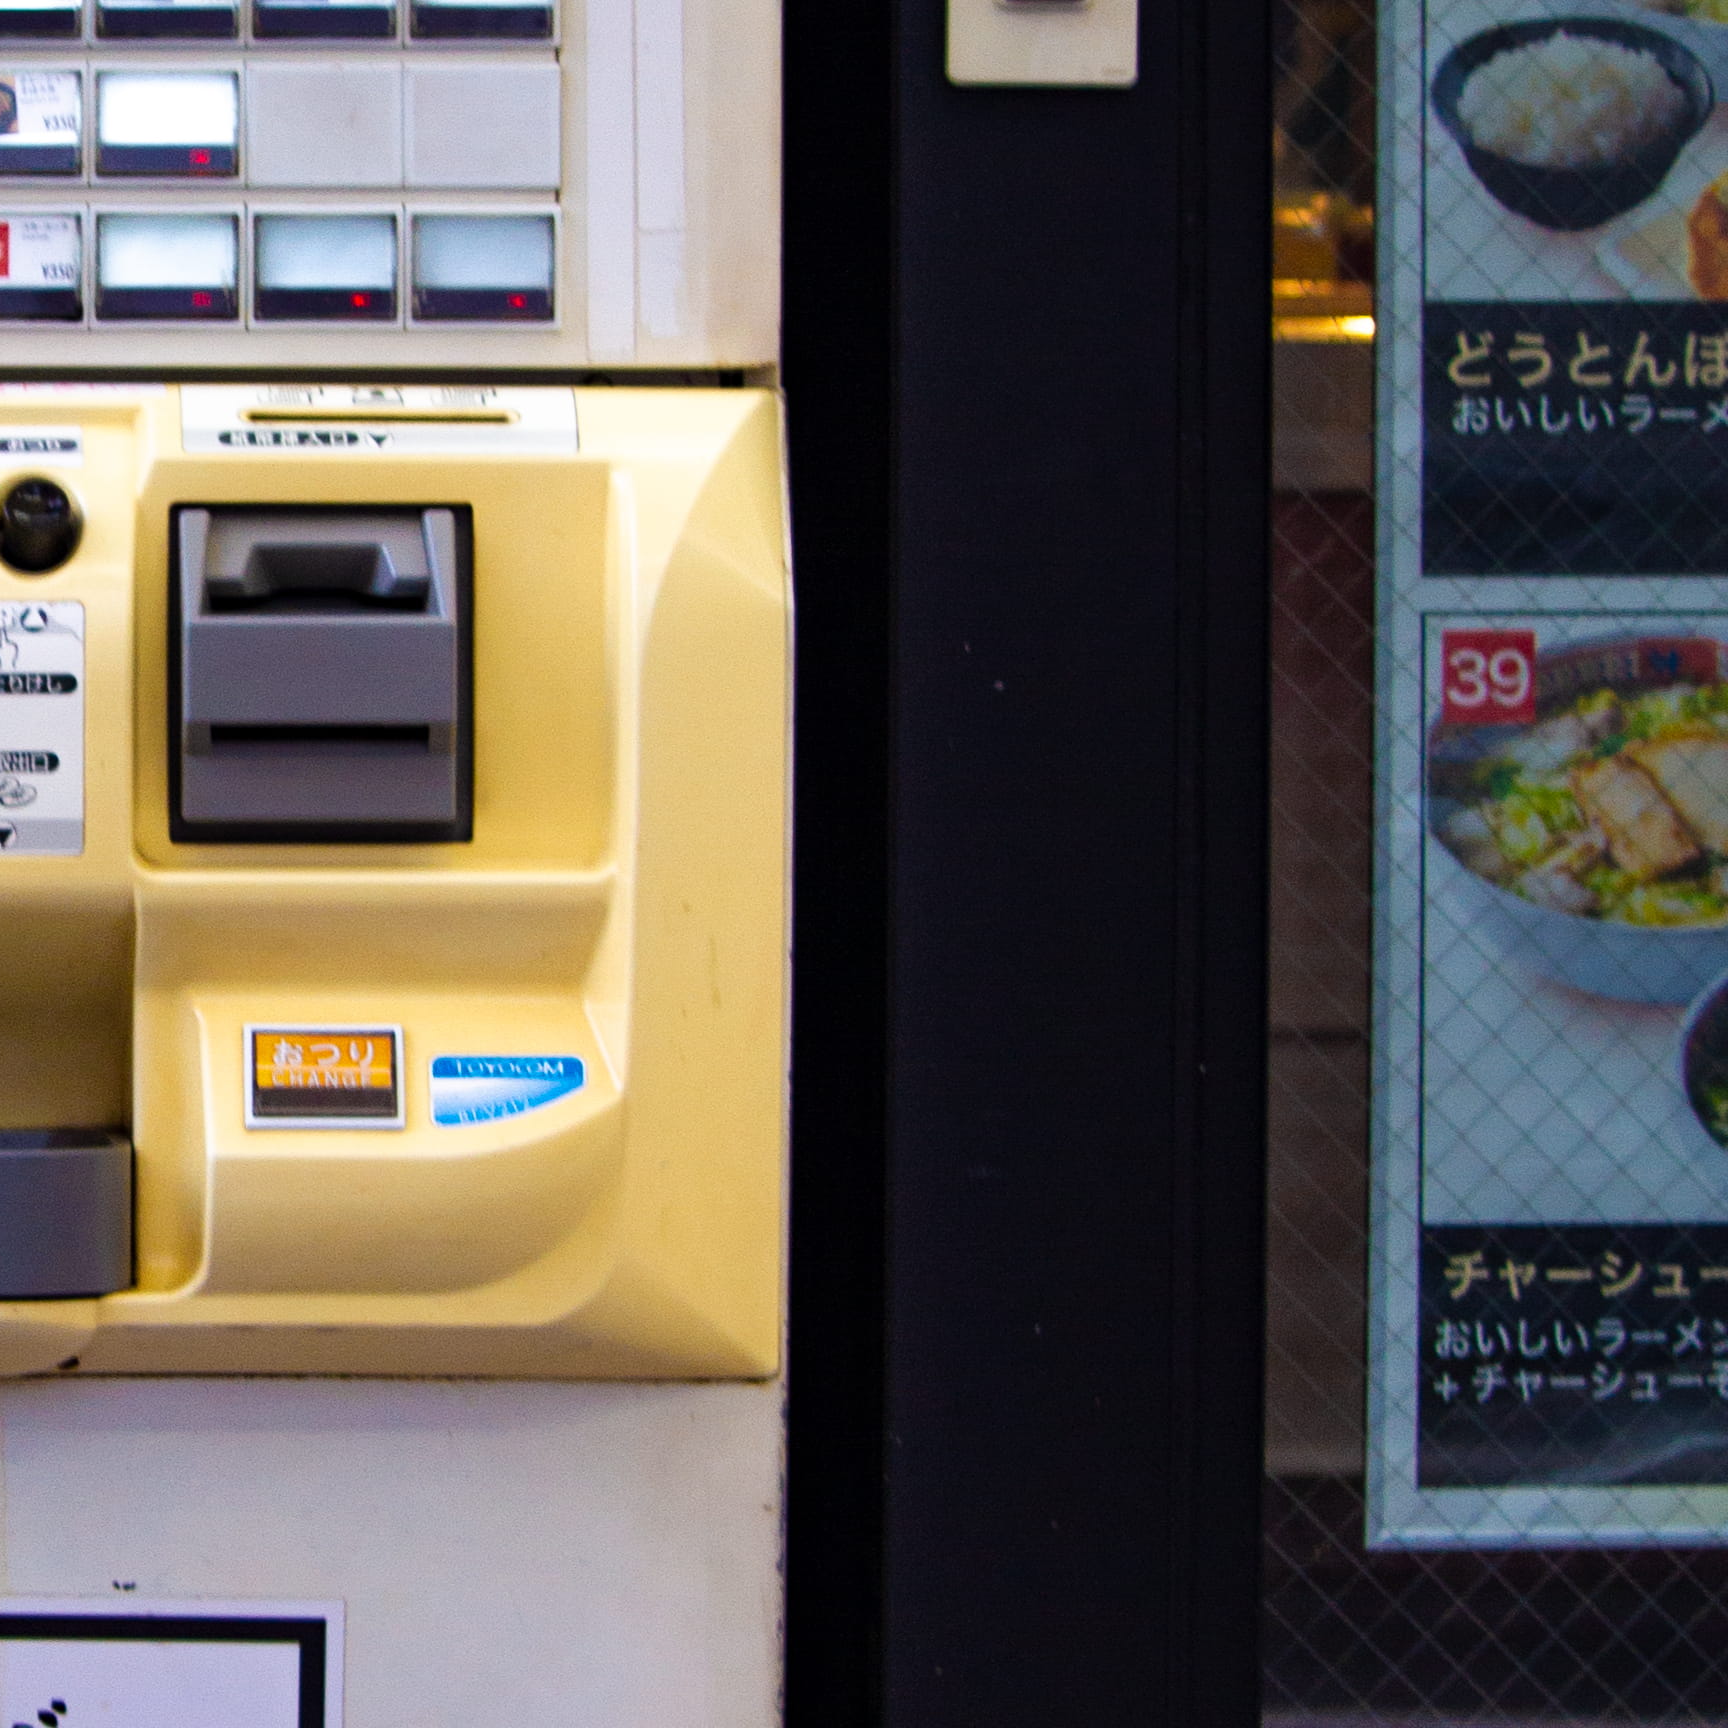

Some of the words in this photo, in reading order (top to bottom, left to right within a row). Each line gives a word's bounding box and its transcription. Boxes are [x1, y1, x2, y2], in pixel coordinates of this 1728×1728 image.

[1447, 649, 1530, 708] 39
[272, 1038, 374, 1066] おつり
[272, 1071, 373, 1089] CHANGE
